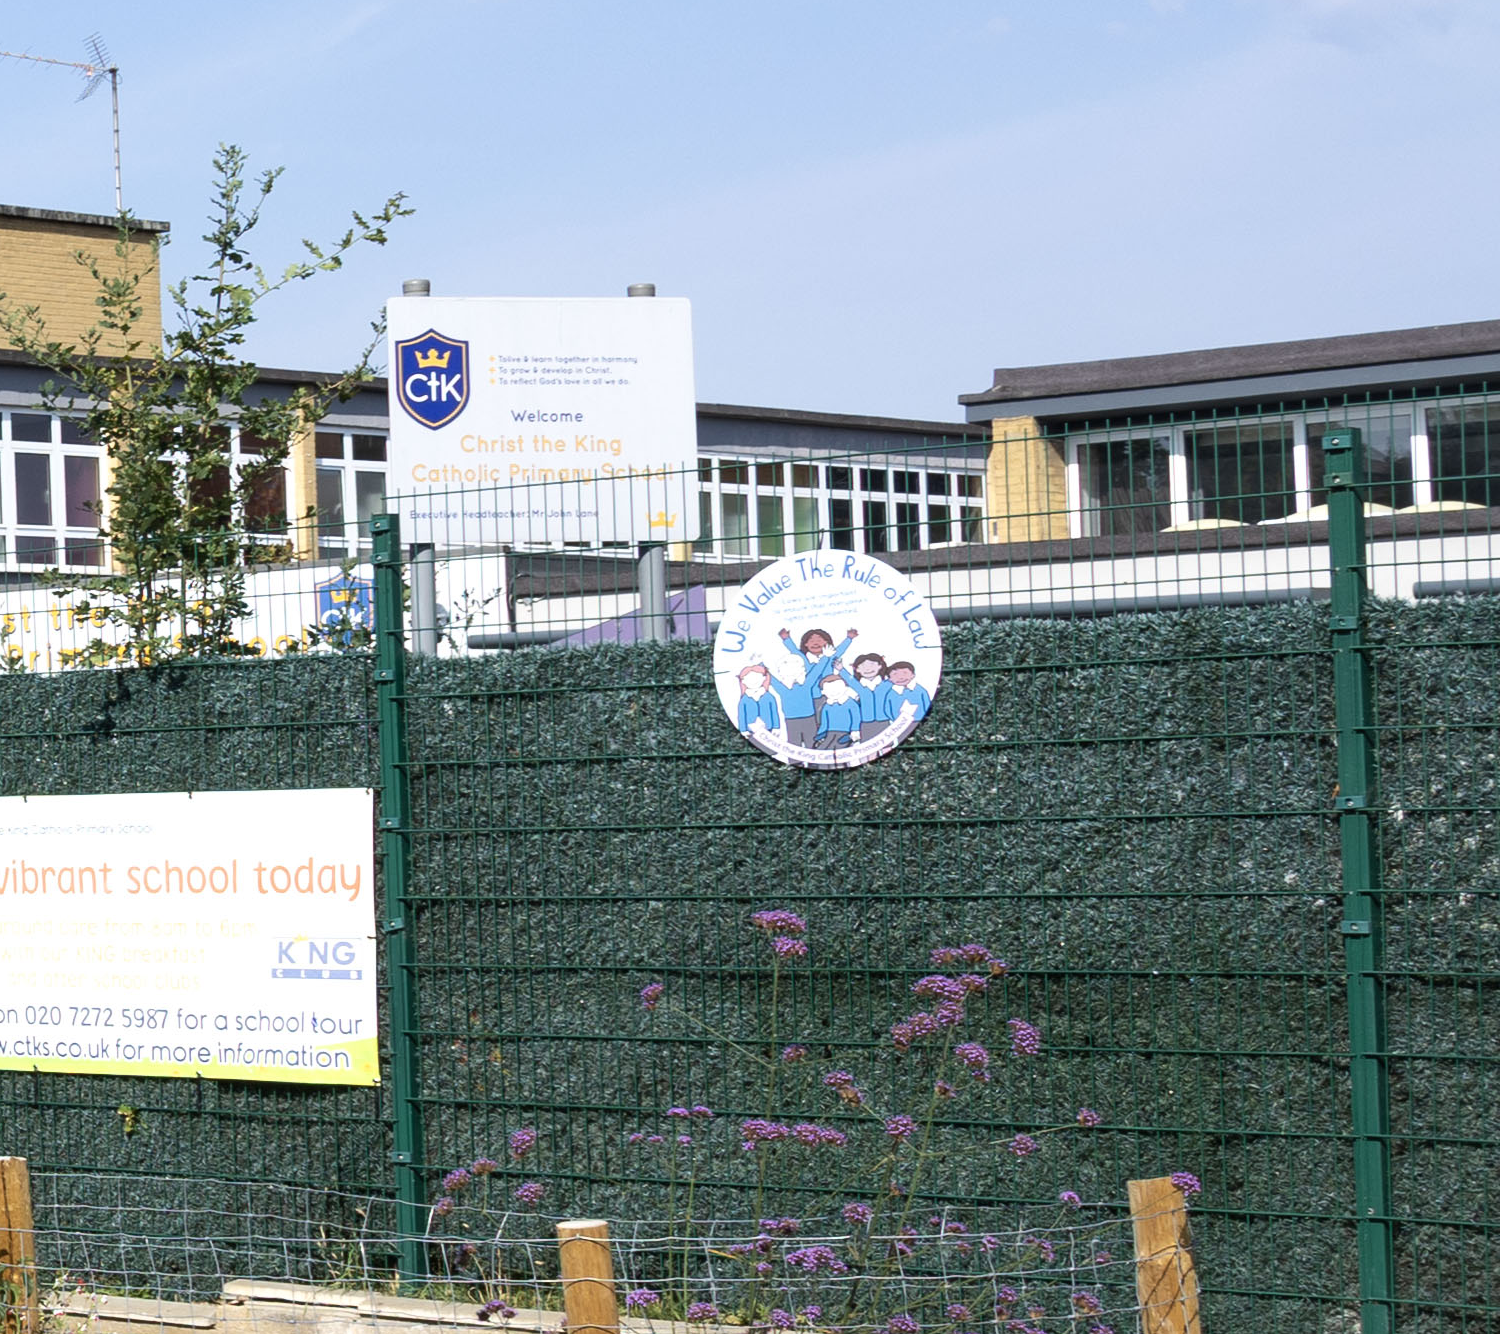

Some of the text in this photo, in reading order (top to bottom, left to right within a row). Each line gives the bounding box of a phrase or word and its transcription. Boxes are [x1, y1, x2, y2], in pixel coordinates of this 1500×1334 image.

[498, 366, 508, 374] To
[541, 367, 573, 375] develop
[555, 356, 590, 364] together
[404, 372, 462, 403] CtK
[498, 377, 508, 385] To
[510, 377, 537, 385] reflect
[539, 377, 562, 385] God's
[564, 377, 580, 385] love
[583, 377, 590, 385] in
[510, 409, 584, 422] Welcome
[460, 434, 622, 456] Christ the King
[412, 462, 674, 486] Catholic Primary School
[721, 555, 928, 653] We Value The Rule of Law
[126, 859, 237, 894] school
[253, 856, 361, 902] today
[25, 1006, 62, 1026] 020
[69, 1007, 115, 1027] 7272
[122, 1008, 169, 1029] 5987
[177, 1008, 207, 1030] for
[214, 1014, 228, 1030] a
[235, 1010, 305, 1033] school
[311, 1011, 363, 1034] tour
[115, 1038, 145, 1060] for
[151, 1046, 211, 1063] more
[217, 1042, 350, 1067] information
